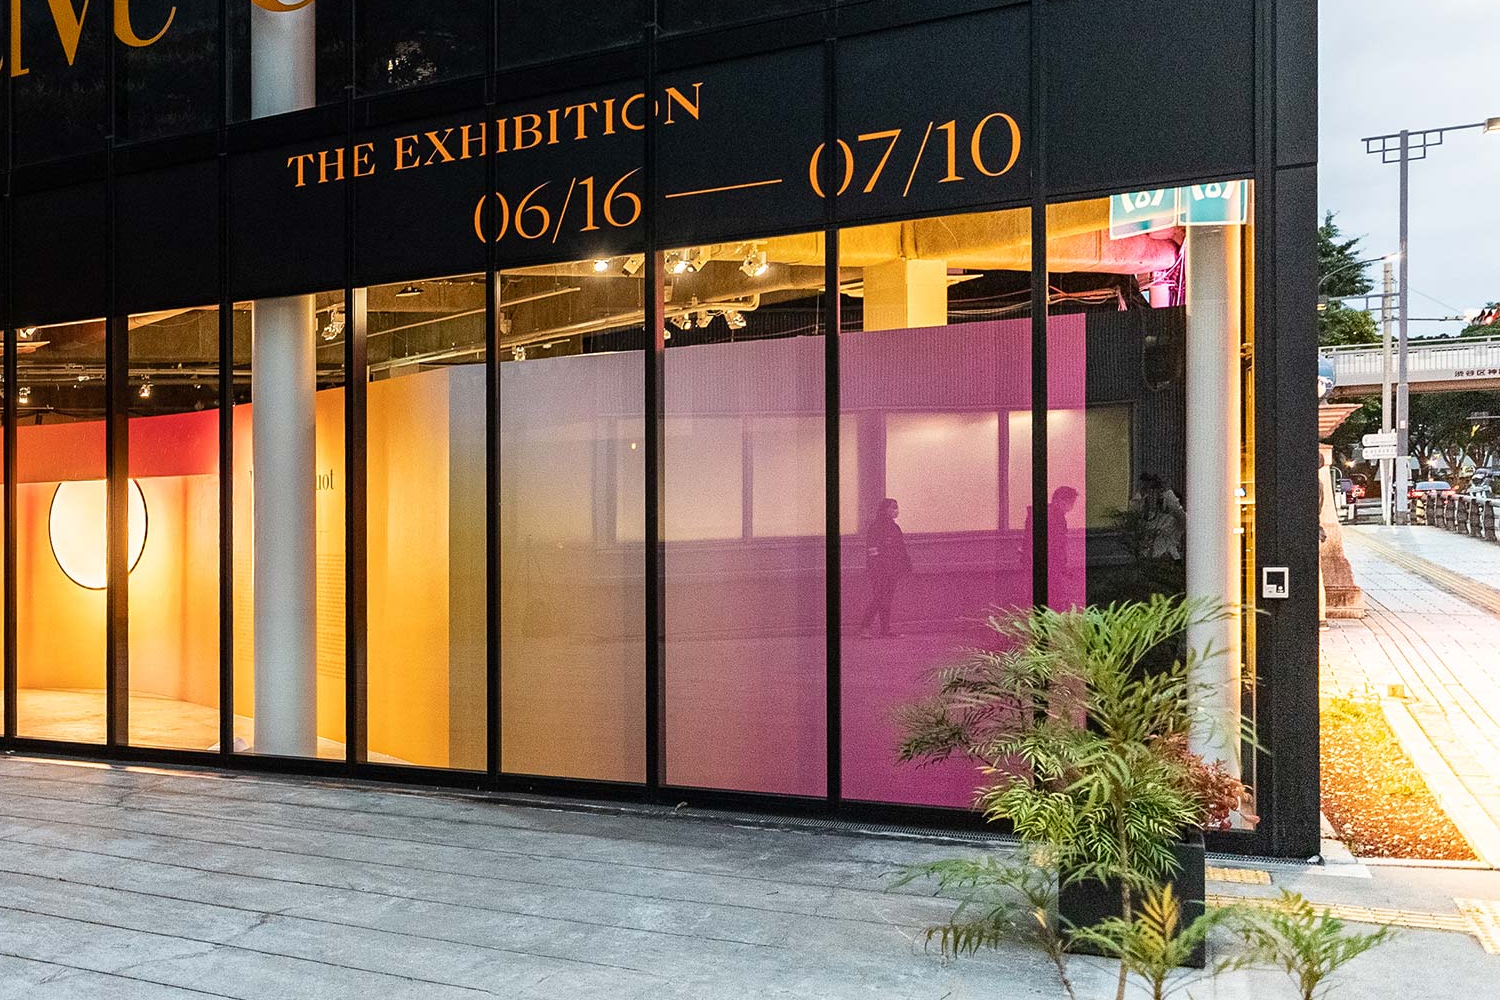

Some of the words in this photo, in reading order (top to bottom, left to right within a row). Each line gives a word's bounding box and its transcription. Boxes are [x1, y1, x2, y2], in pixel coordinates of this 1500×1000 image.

[287, 141, 376, 188] THE
[394, 82, 704, 171] EXHIBITION
[473, 166, 643, 244] 06/16
[808, 112, 1022, 198] 07/10
